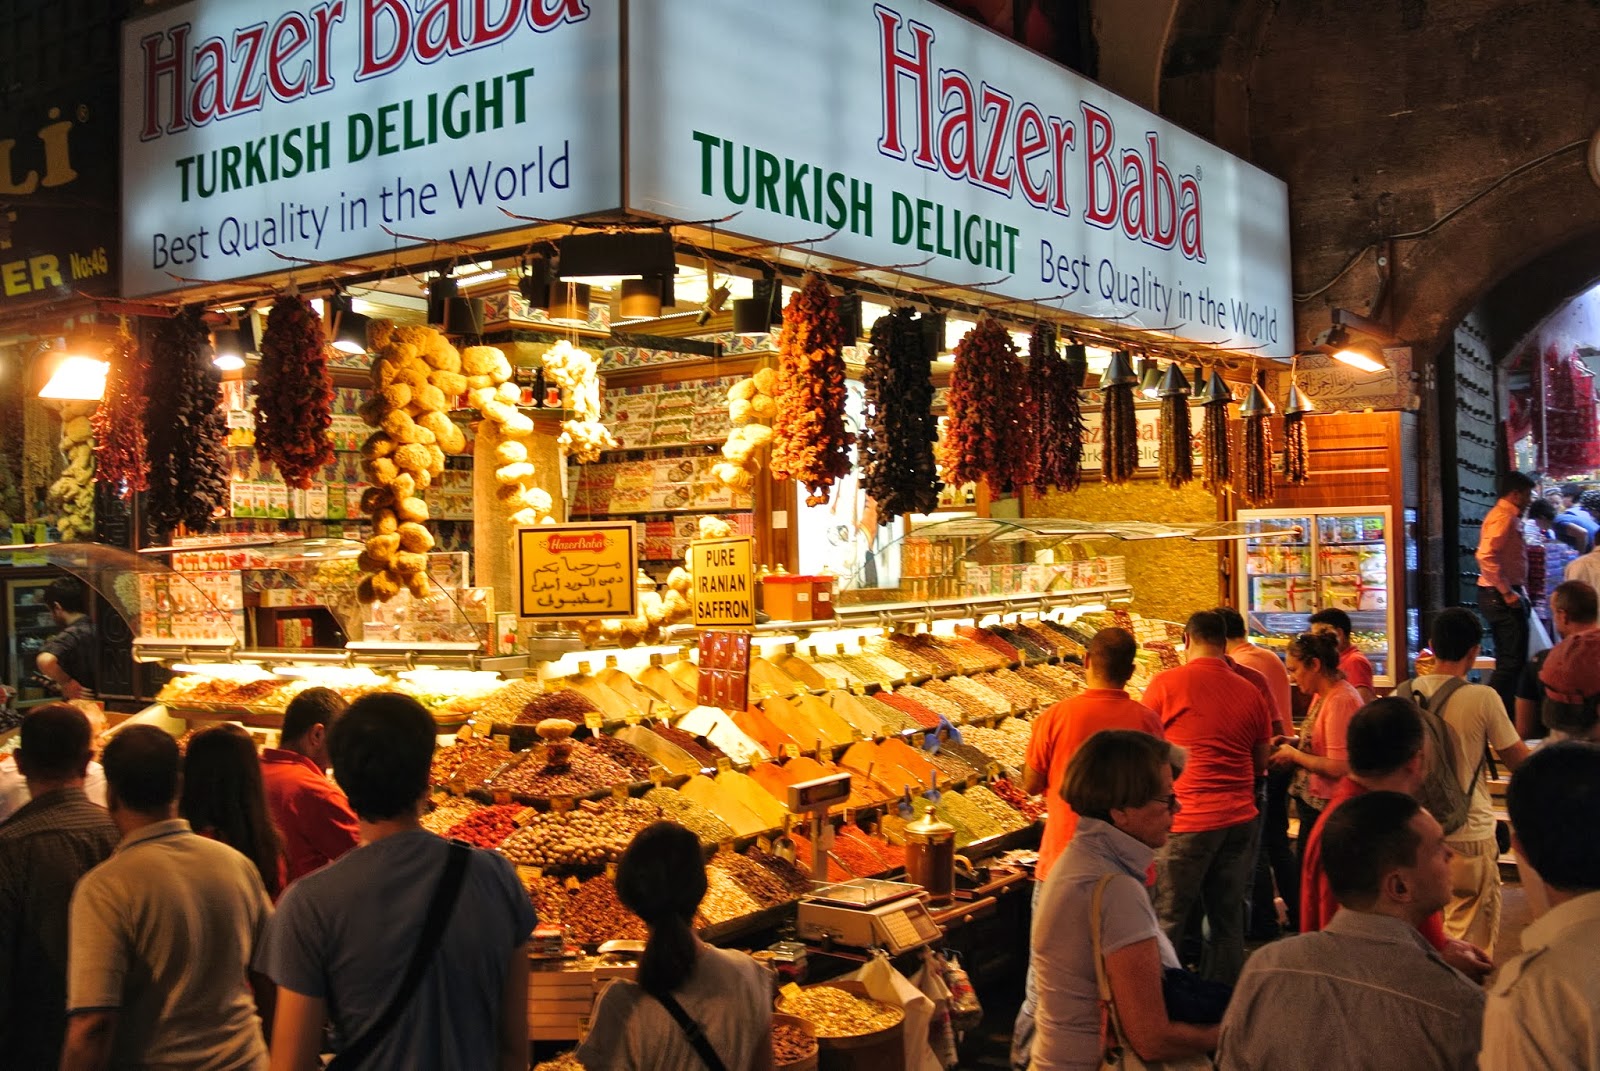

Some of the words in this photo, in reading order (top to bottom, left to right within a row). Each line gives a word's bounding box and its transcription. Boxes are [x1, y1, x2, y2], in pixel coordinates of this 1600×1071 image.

[141, 0, 347, 141] Hazer
[175, 121, 330, 202] TURKISH
[348, 68, 534, 163] DELIGHT
[873, 3, 1076, 217] Hazer
[1080, 100, 1206, 264] Baba
[153, 226, 209, 269] Best
[218, 202, 329, 257] Quality
[341, 192, 367, 232] in
[379, 177, 437, 223] the
[449, 140, 569, 209] World
[693, 130, 872, 237] TURKISH
[892, 190, 1020, 274] DELIGHT
[1040, 239, 1091, 294] Best
[1098, 258, 1172, 325] Quality
[1178, 281, 1192, 321] in
[1198, 287, 1226, 330] the
[1230, 298, 1278, 343] World
[698, 574, 746, 593] IRANIAN
[698, 600, 749, 619] SAFFRON
[706, 548, 736, 568] PURE
